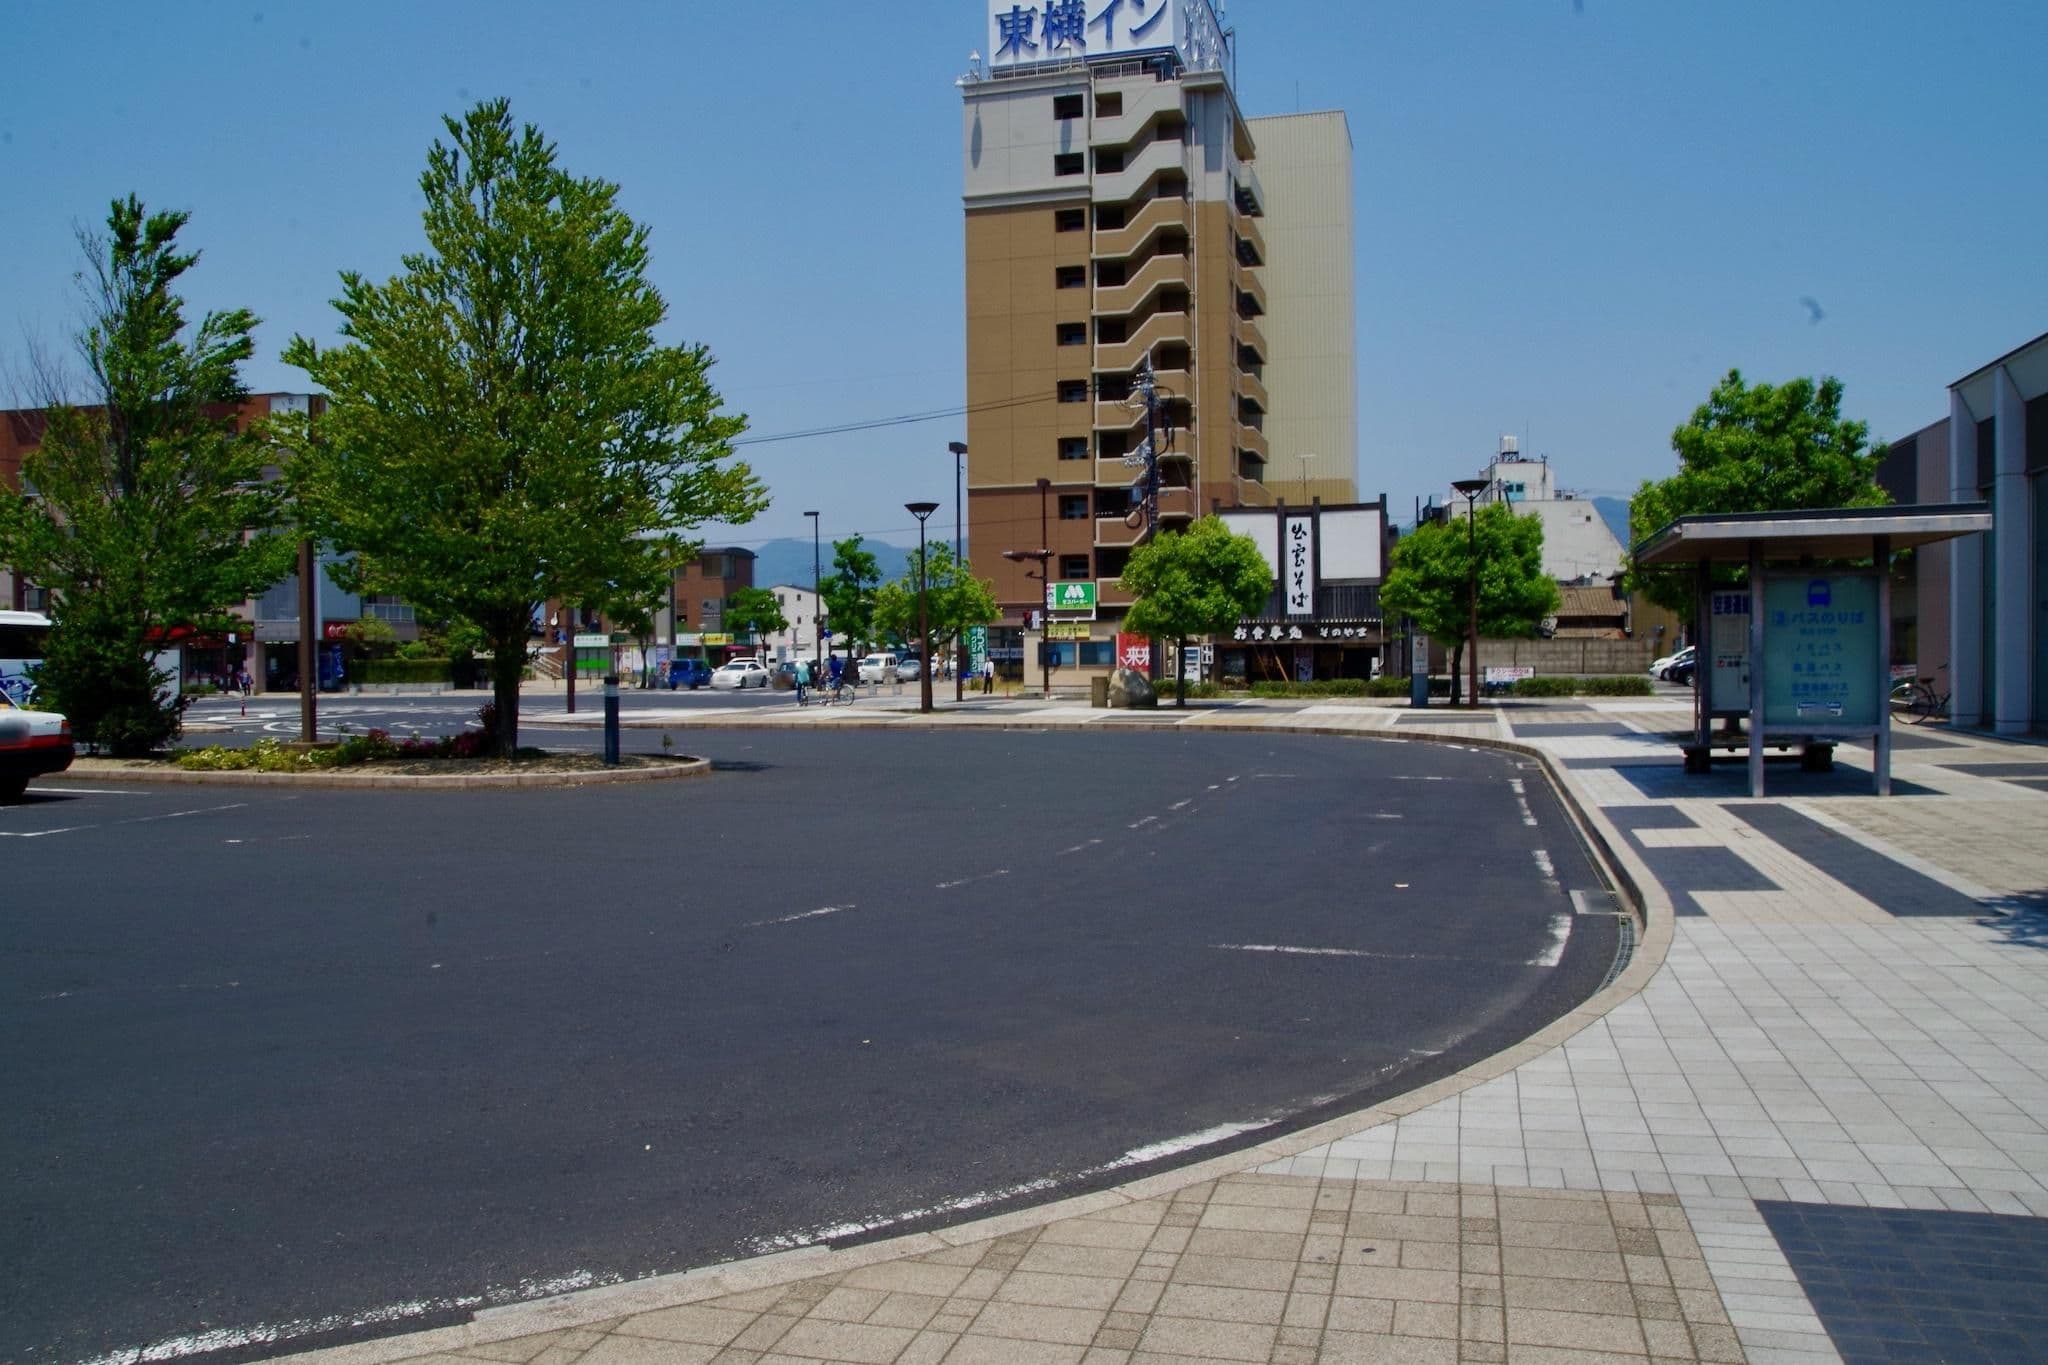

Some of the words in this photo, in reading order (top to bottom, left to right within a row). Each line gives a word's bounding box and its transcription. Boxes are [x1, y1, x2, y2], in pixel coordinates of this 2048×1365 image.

[995, 0, 1168, 56] 東横イン
[1291, 522, 1309, 608] 出雲そば
